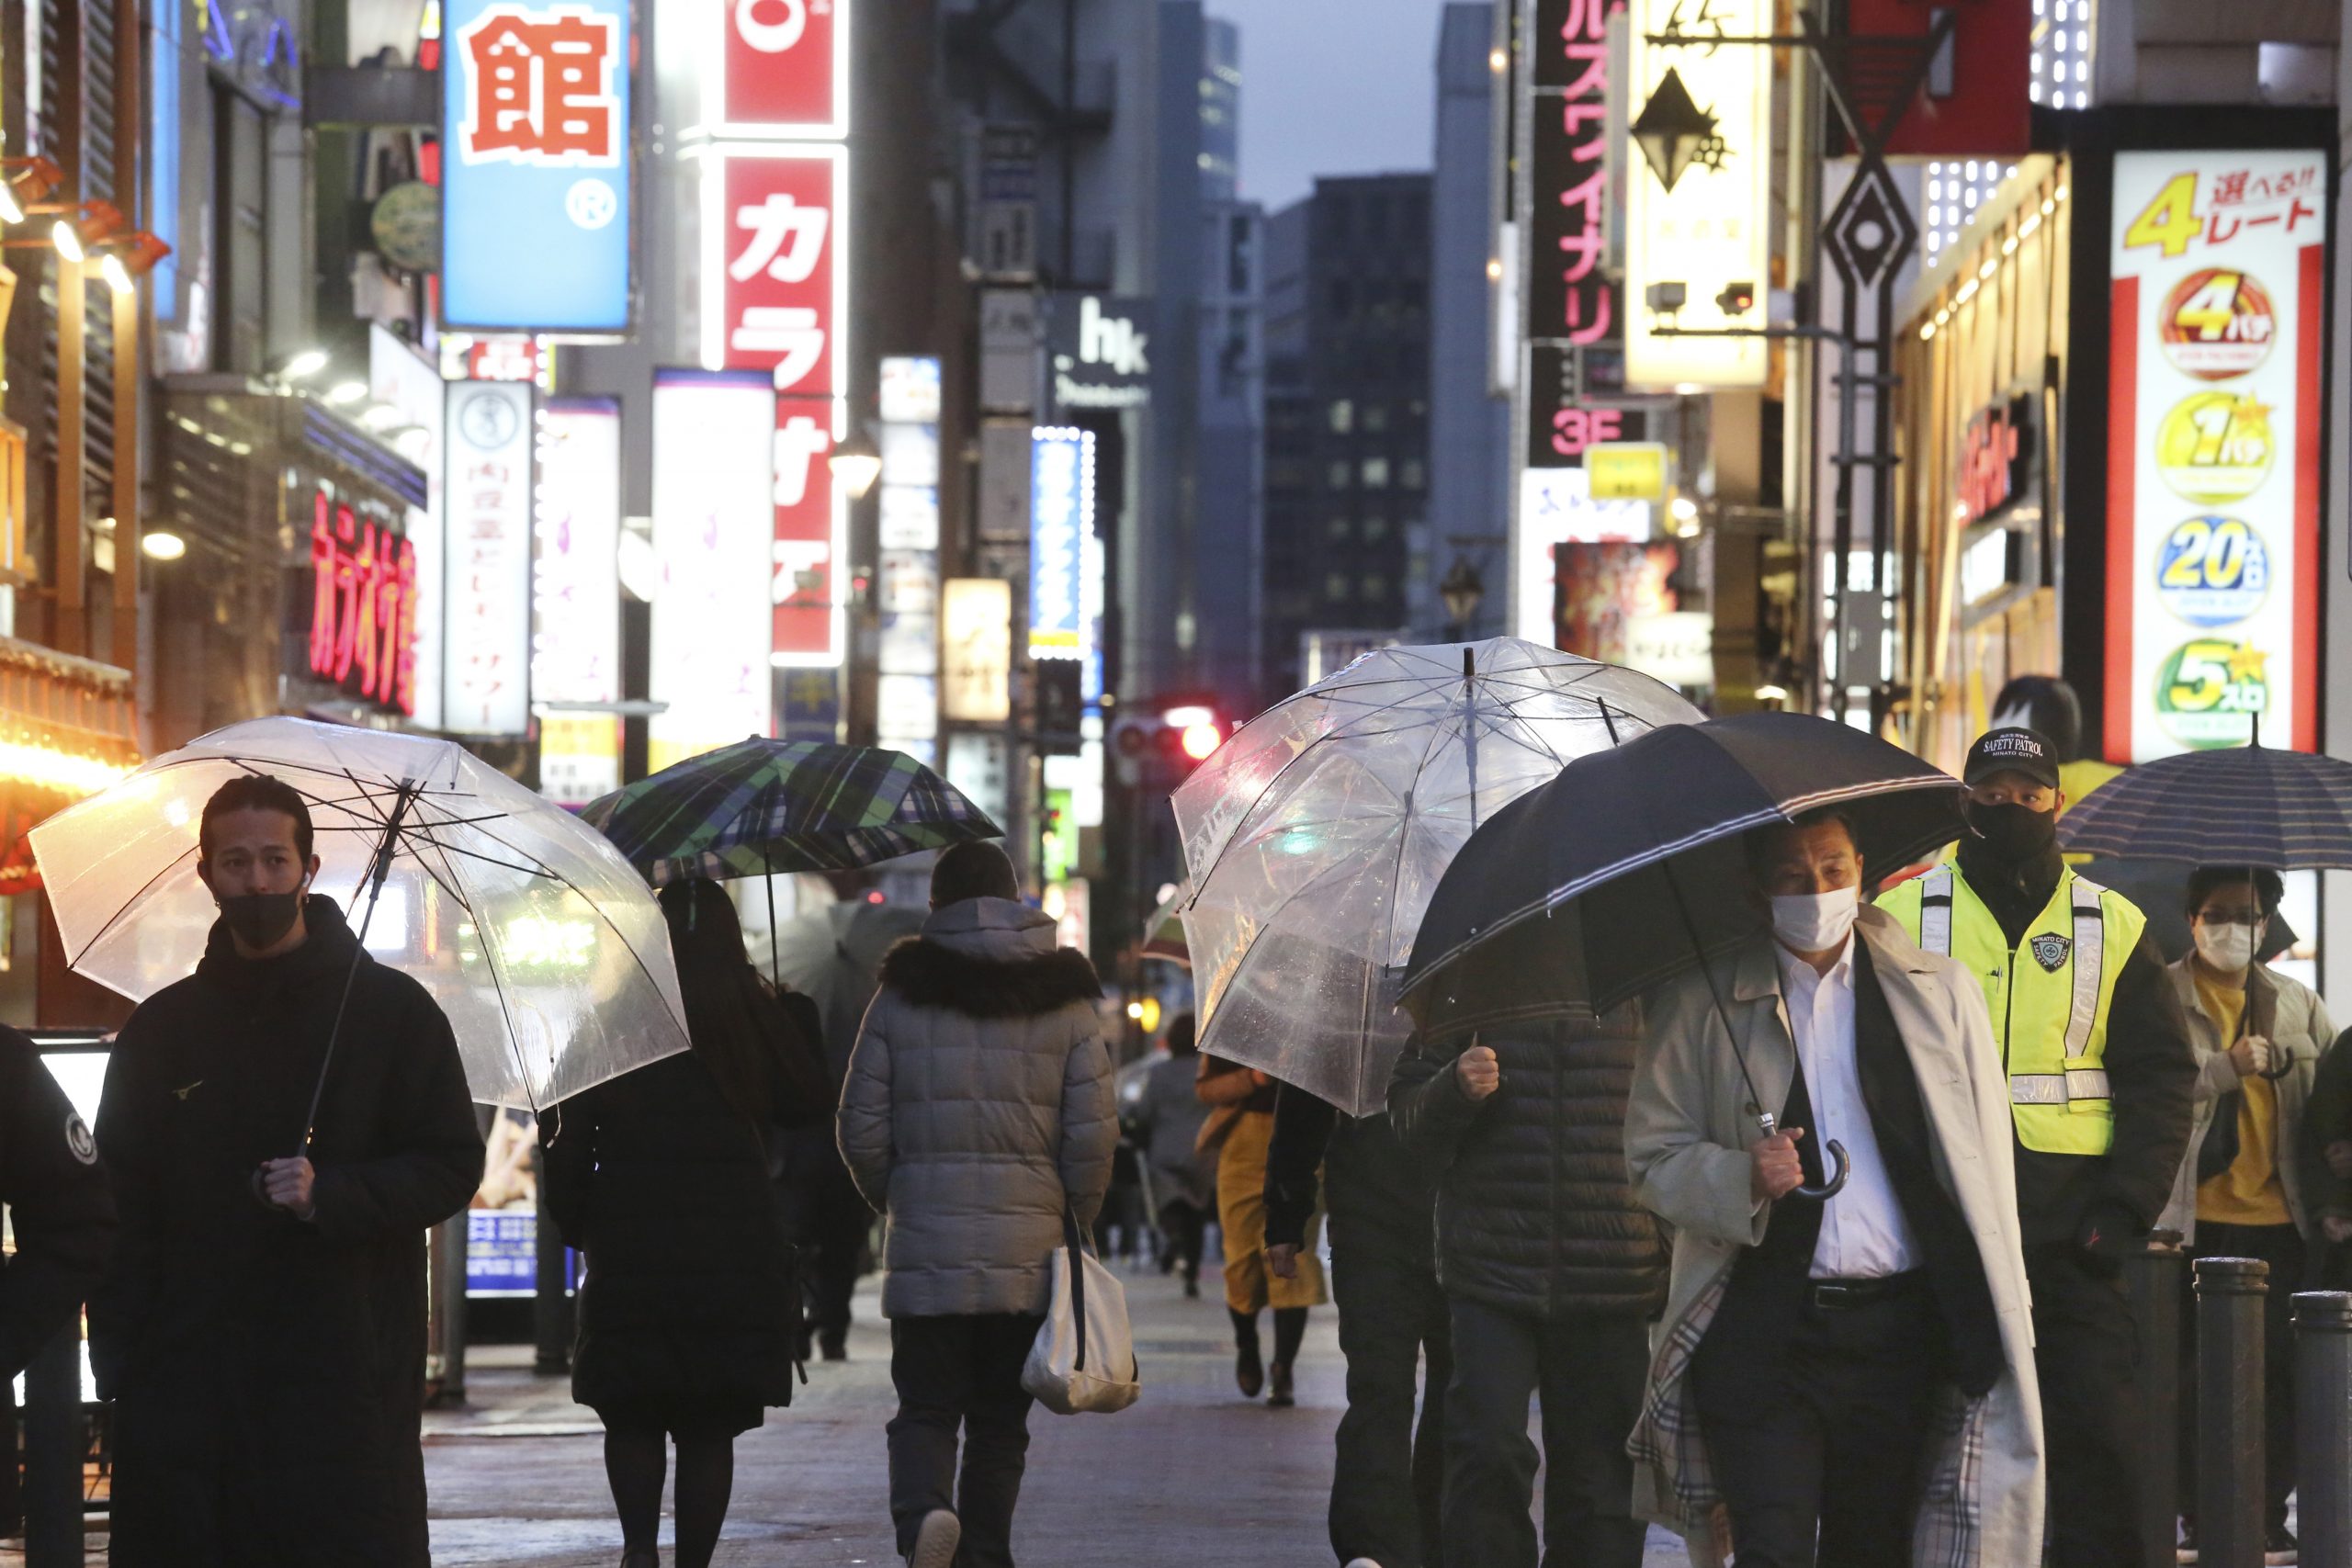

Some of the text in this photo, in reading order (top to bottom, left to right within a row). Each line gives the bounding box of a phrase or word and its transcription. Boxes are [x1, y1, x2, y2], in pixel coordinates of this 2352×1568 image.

[457, 4, 620, 168] 館
[1560, 0, 1613, 345] ルスワイナリ
[2123, 170, 2204, 258] 4
[2206, 197, 2313, 244] レート
[1551, 408, 1623, 456] 3F
[1983, 738, 2043, 757] SAFETY PATROL
[2033, 944, 2049, 966] SAFETY
[2053, 948, 2068, 967] PATROL
[2055, 937, 2070, 945] CITY
